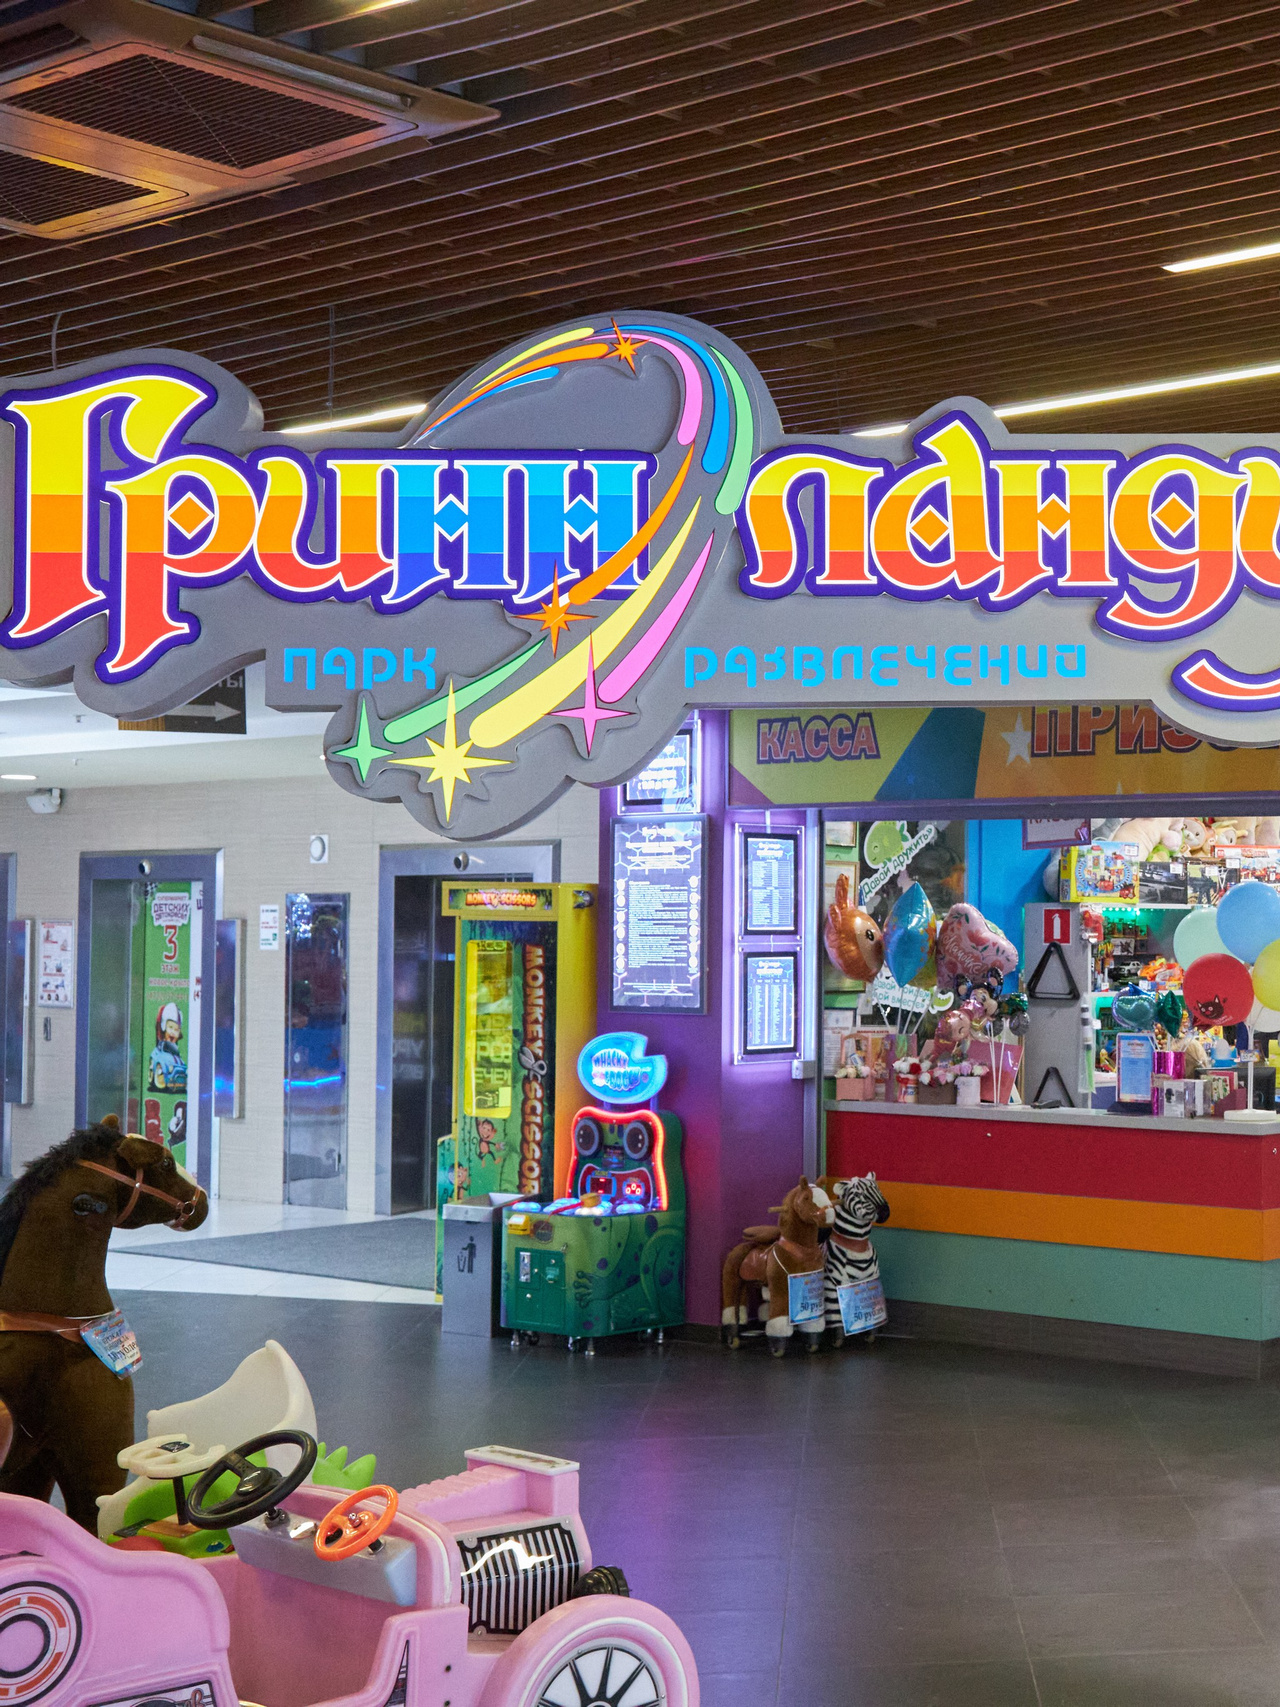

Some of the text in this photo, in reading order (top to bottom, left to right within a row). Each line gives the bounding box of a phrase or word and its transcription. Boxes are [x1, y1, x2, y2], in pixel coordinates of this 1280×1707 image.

[757, 714, 880, 764] КАССА
[862, 827, 933, 898] Давай дружить»
[153, 902, 190, 913] ДЕТСКИХ
[500, 892, 537, 907] SCISSORS
[163, 924, 178, 961] 3
[520, 945, 546, 1197] MONKEY SCISSOR
